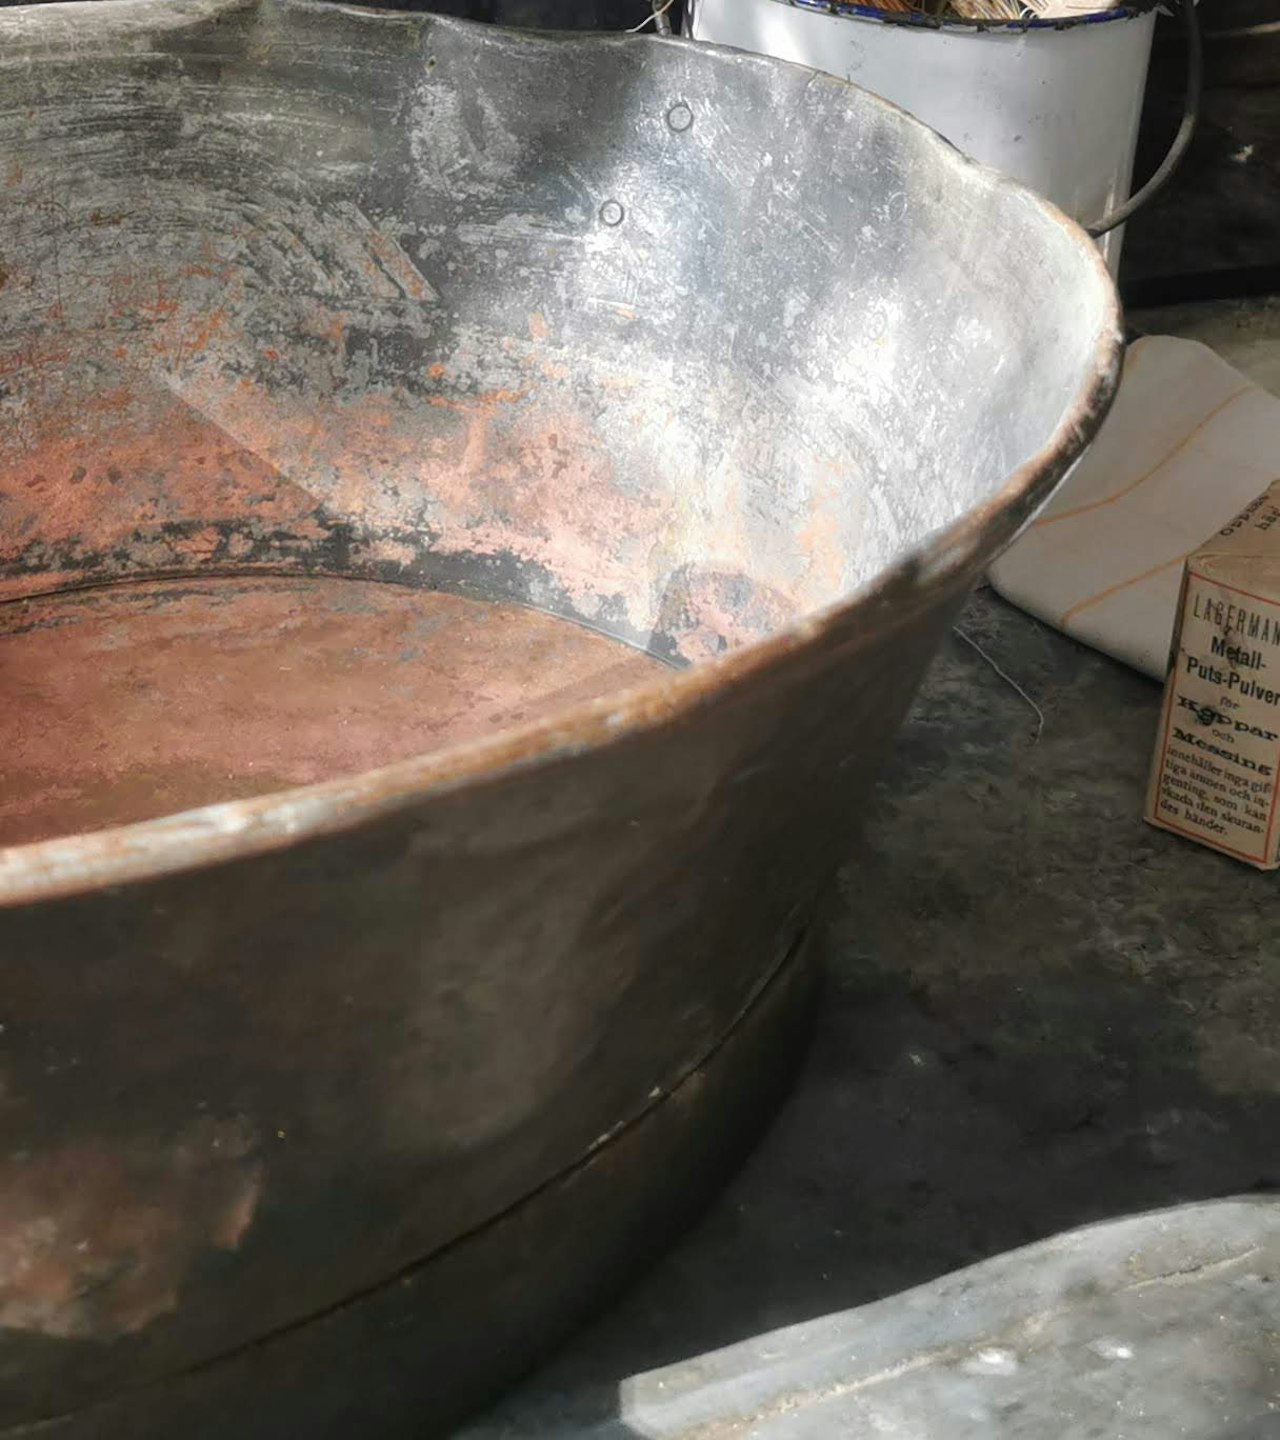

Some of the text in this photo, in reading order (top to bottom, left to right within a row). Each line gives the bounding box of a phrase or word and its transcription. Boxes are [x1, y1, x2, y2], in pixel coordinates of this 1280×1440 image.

[1211, 636, 1266, 670] Metall-
[1172, 726, 1273, 777] Messing
[1212, 728, 1235, 744] och
